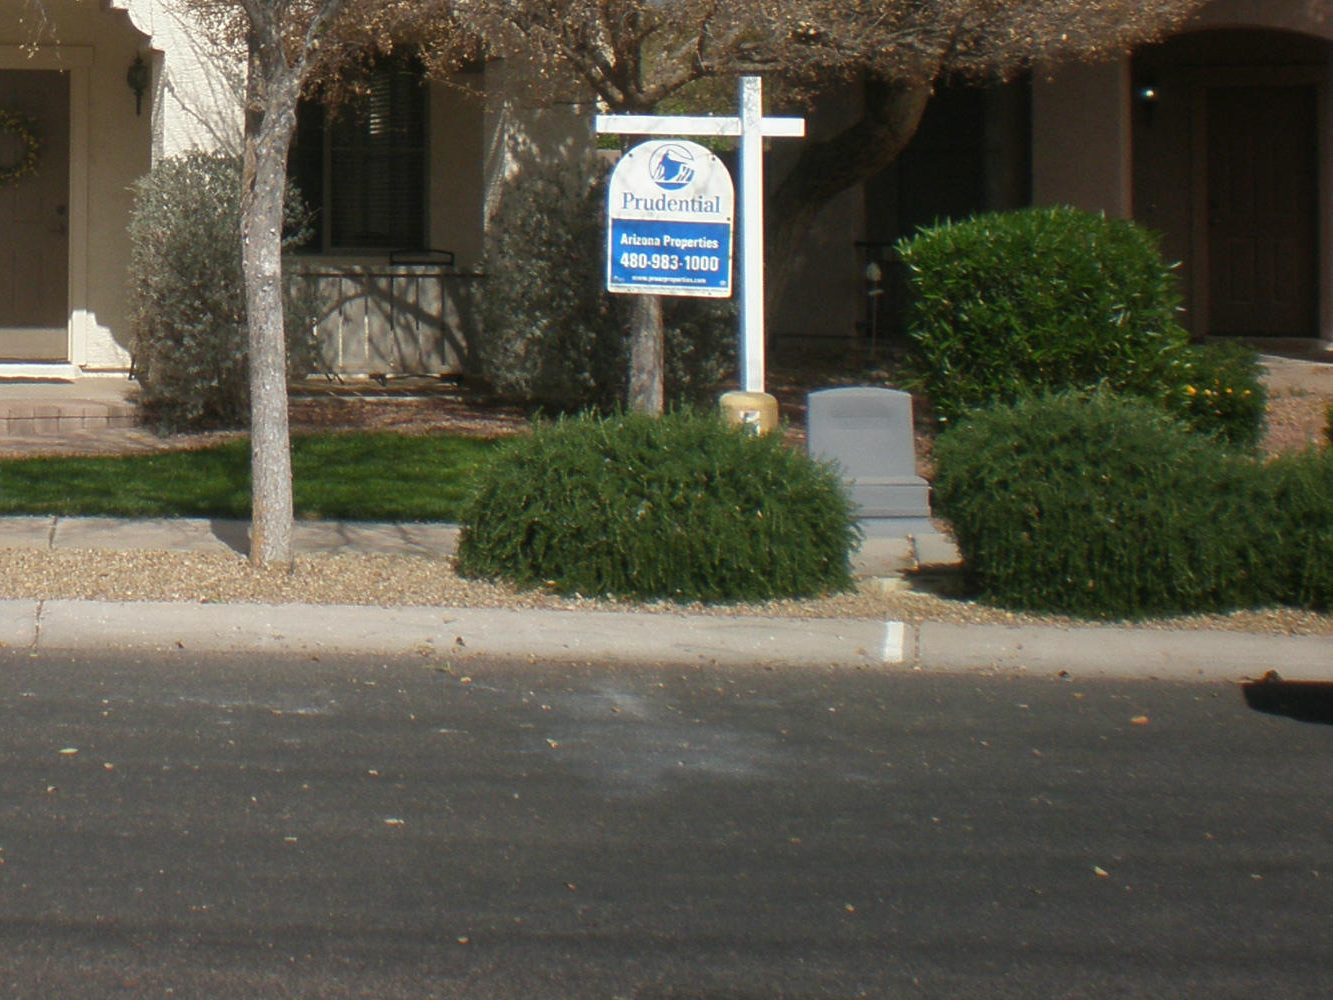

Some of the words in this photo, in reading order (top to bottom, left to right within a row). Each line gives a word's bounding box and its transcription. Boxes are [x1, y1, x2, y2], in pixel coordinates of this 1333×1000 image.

[622, 192, 720, 213] Prudential
[620, 233, 660, 246] Arizona
[663, 235, 719, 250] Properties
